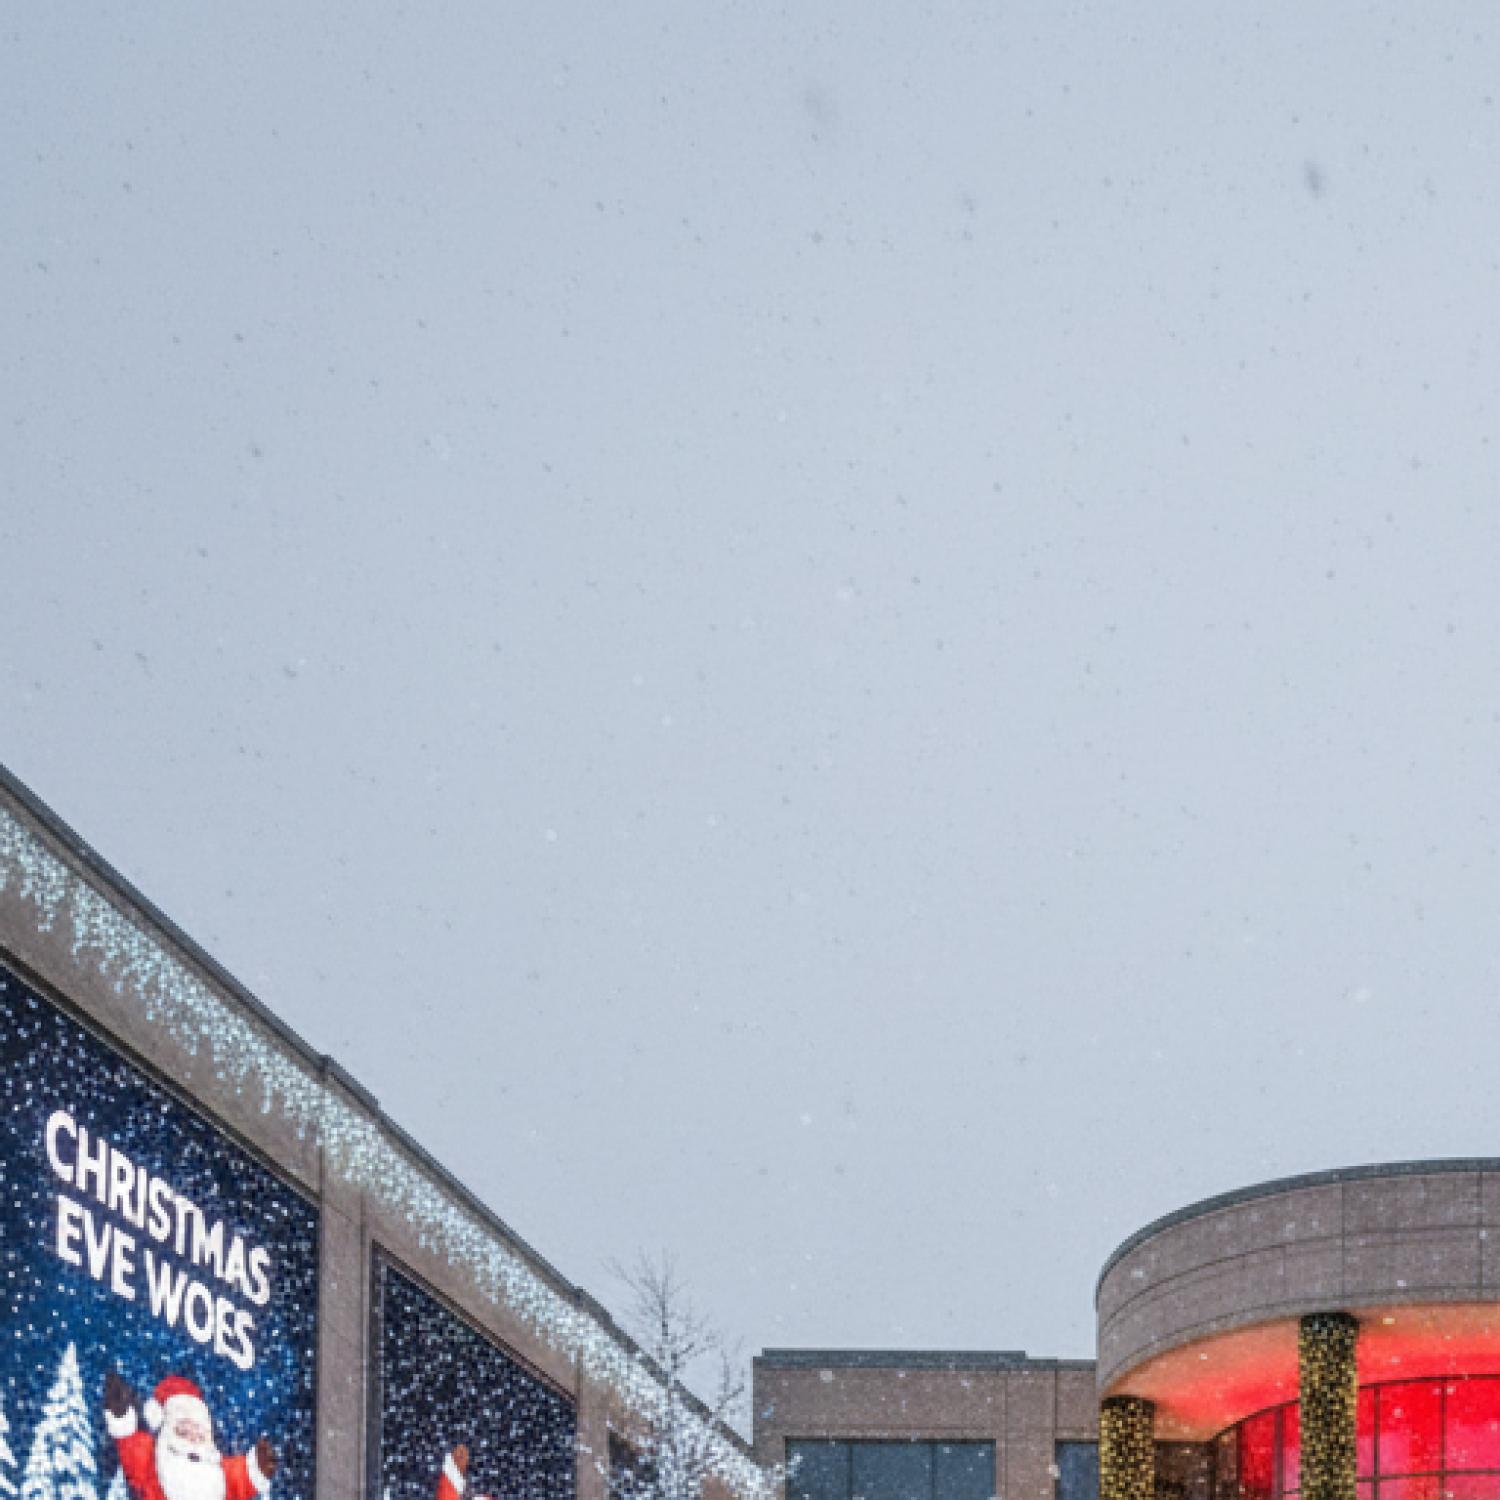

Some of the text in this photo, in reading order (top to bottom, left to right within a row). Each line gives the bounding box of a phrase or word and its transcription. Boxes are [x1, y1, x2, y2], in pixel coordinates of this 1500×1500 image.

[45, 1110, 271, 1305] CHRISTMAS
[56, 1195, 256, 1370] EVE WOES
